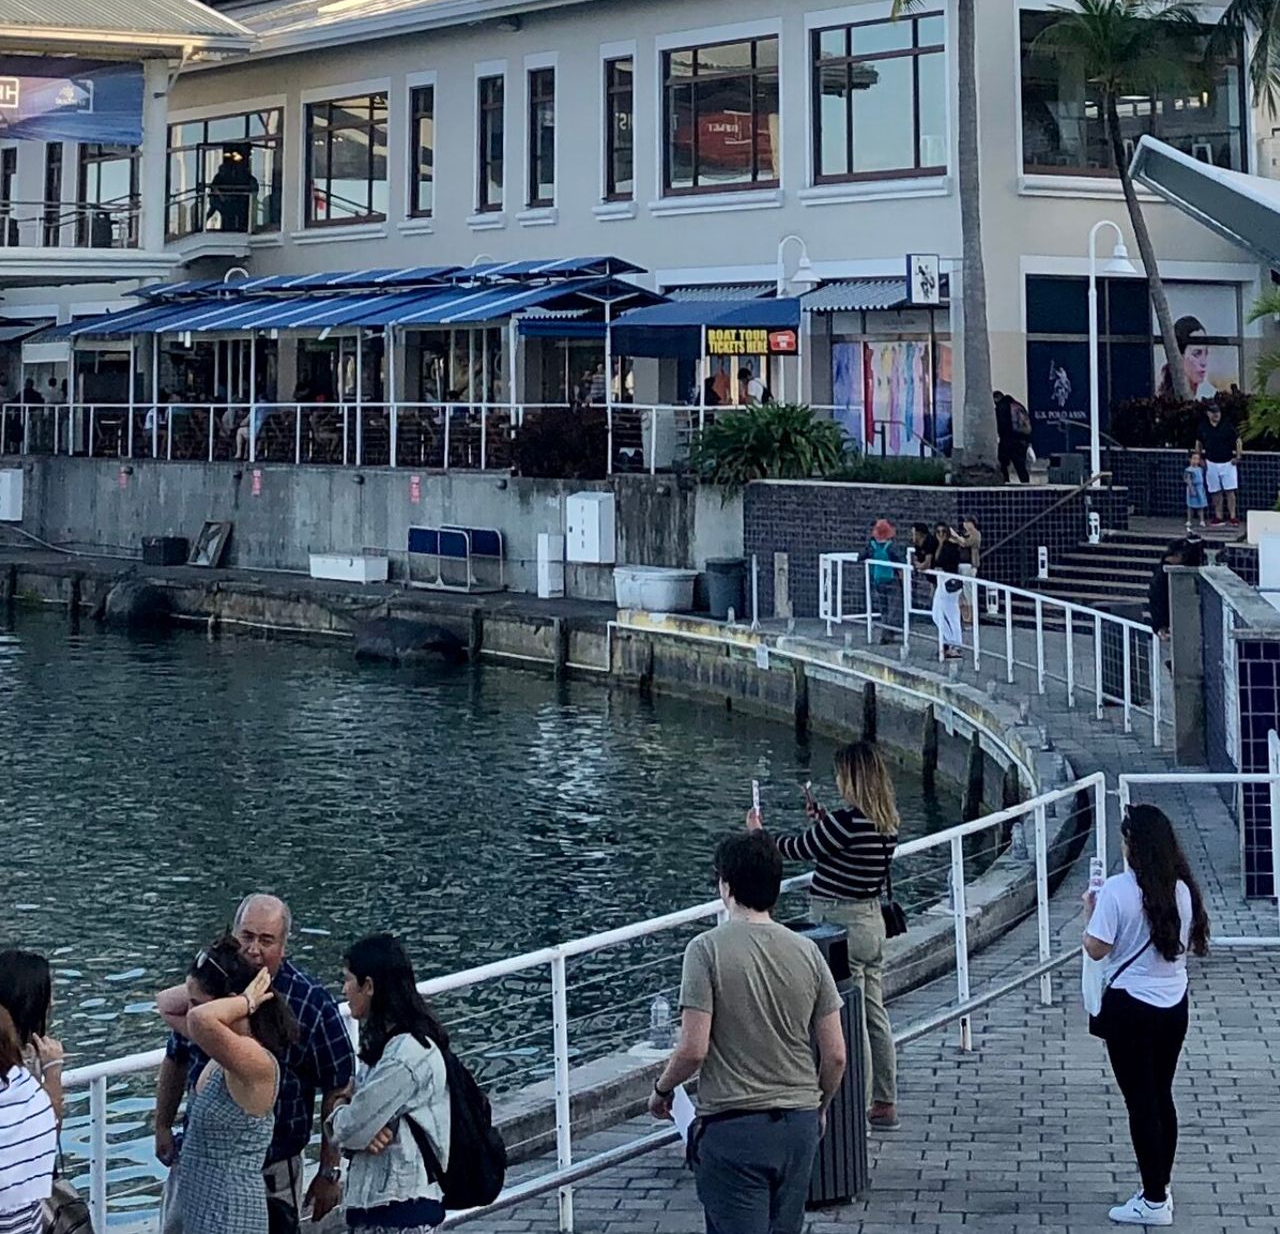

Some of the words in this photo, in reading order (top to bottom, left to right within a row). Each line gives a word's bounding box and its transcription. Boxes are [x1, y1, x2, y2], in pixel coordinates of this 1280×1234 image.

[708, 329, 737, 341] BOAT
[738, 329, 767, 341] TOUR
[709, 341, 745, 354] TICKETS
[746, 341, 768, 354] HERE
